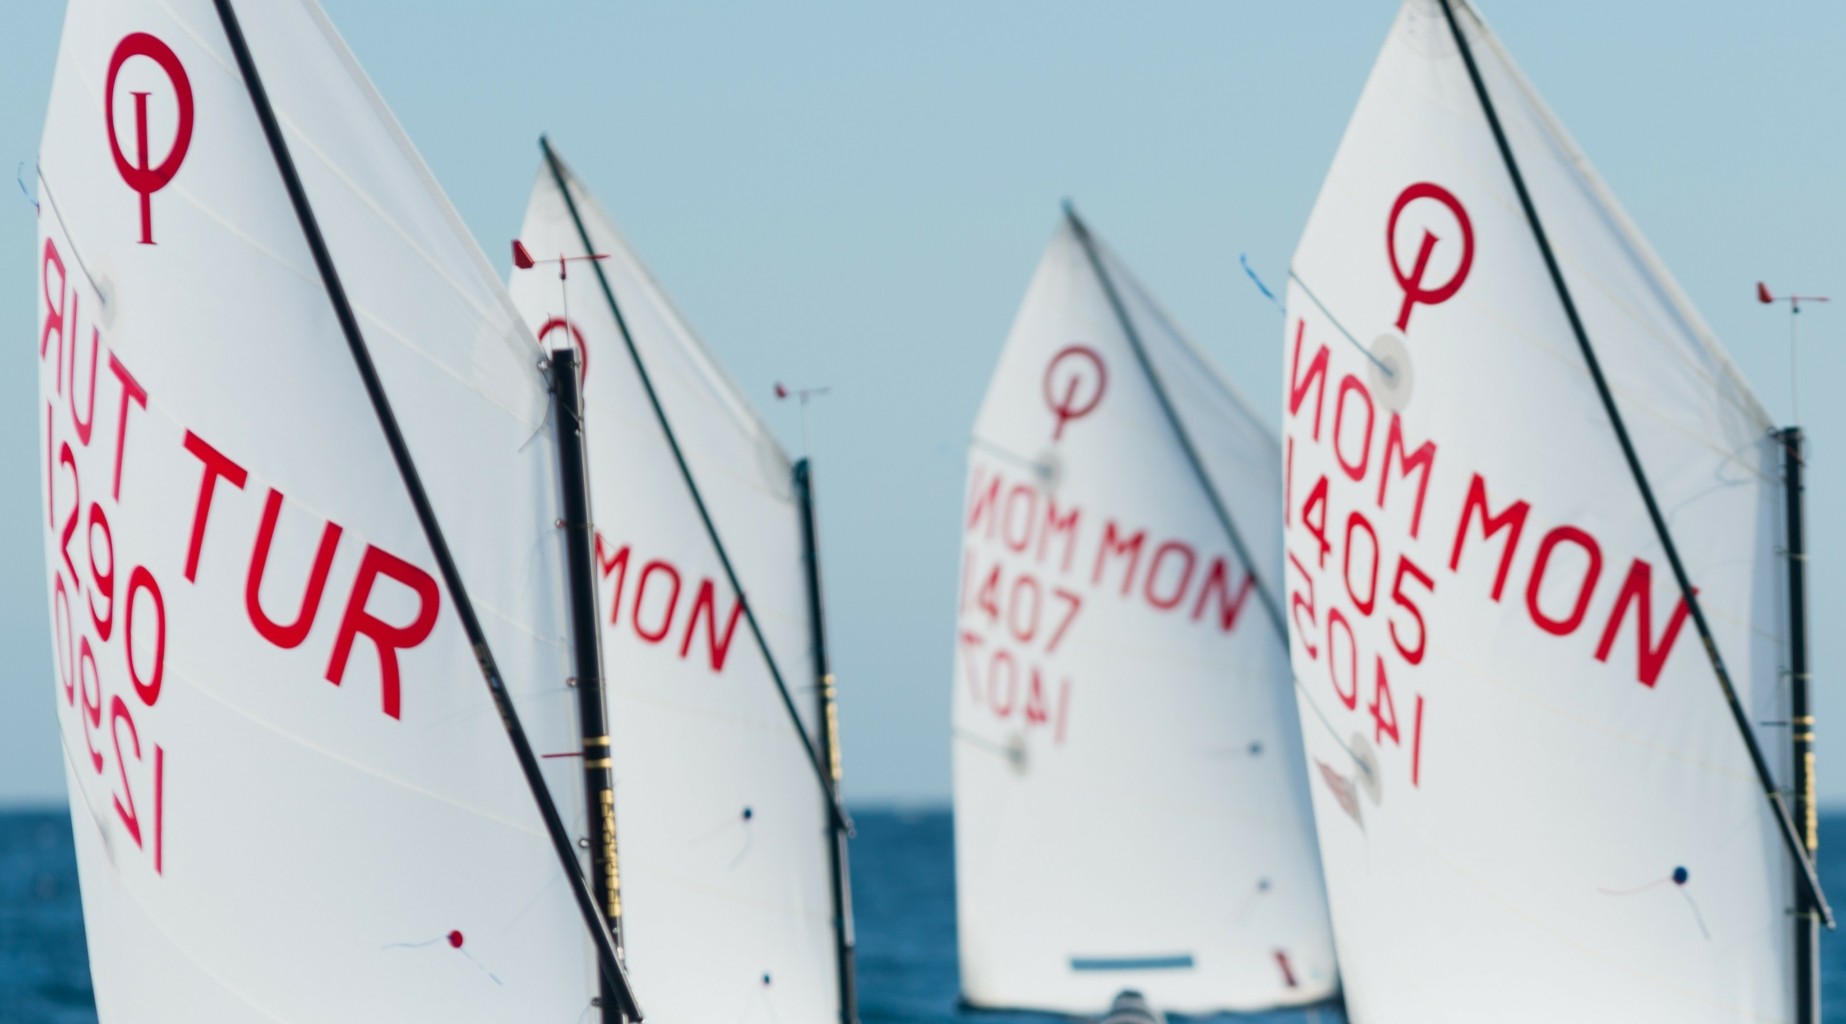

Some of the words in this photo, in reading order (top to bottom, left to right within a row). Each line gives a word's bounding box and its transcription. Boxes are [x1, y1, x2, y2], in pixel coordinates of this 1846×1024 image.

[46, 400, 168, 709] 1290
[182, 427, 441, 722] TUR
[594, 530, 747, 675] MON
[960, 547, 1083, 656] 1407
[1092, 518, 1258, 633] MON
[1284, 436, 1437, 668] 1405
[1447, 471, 1700, 690] MON
